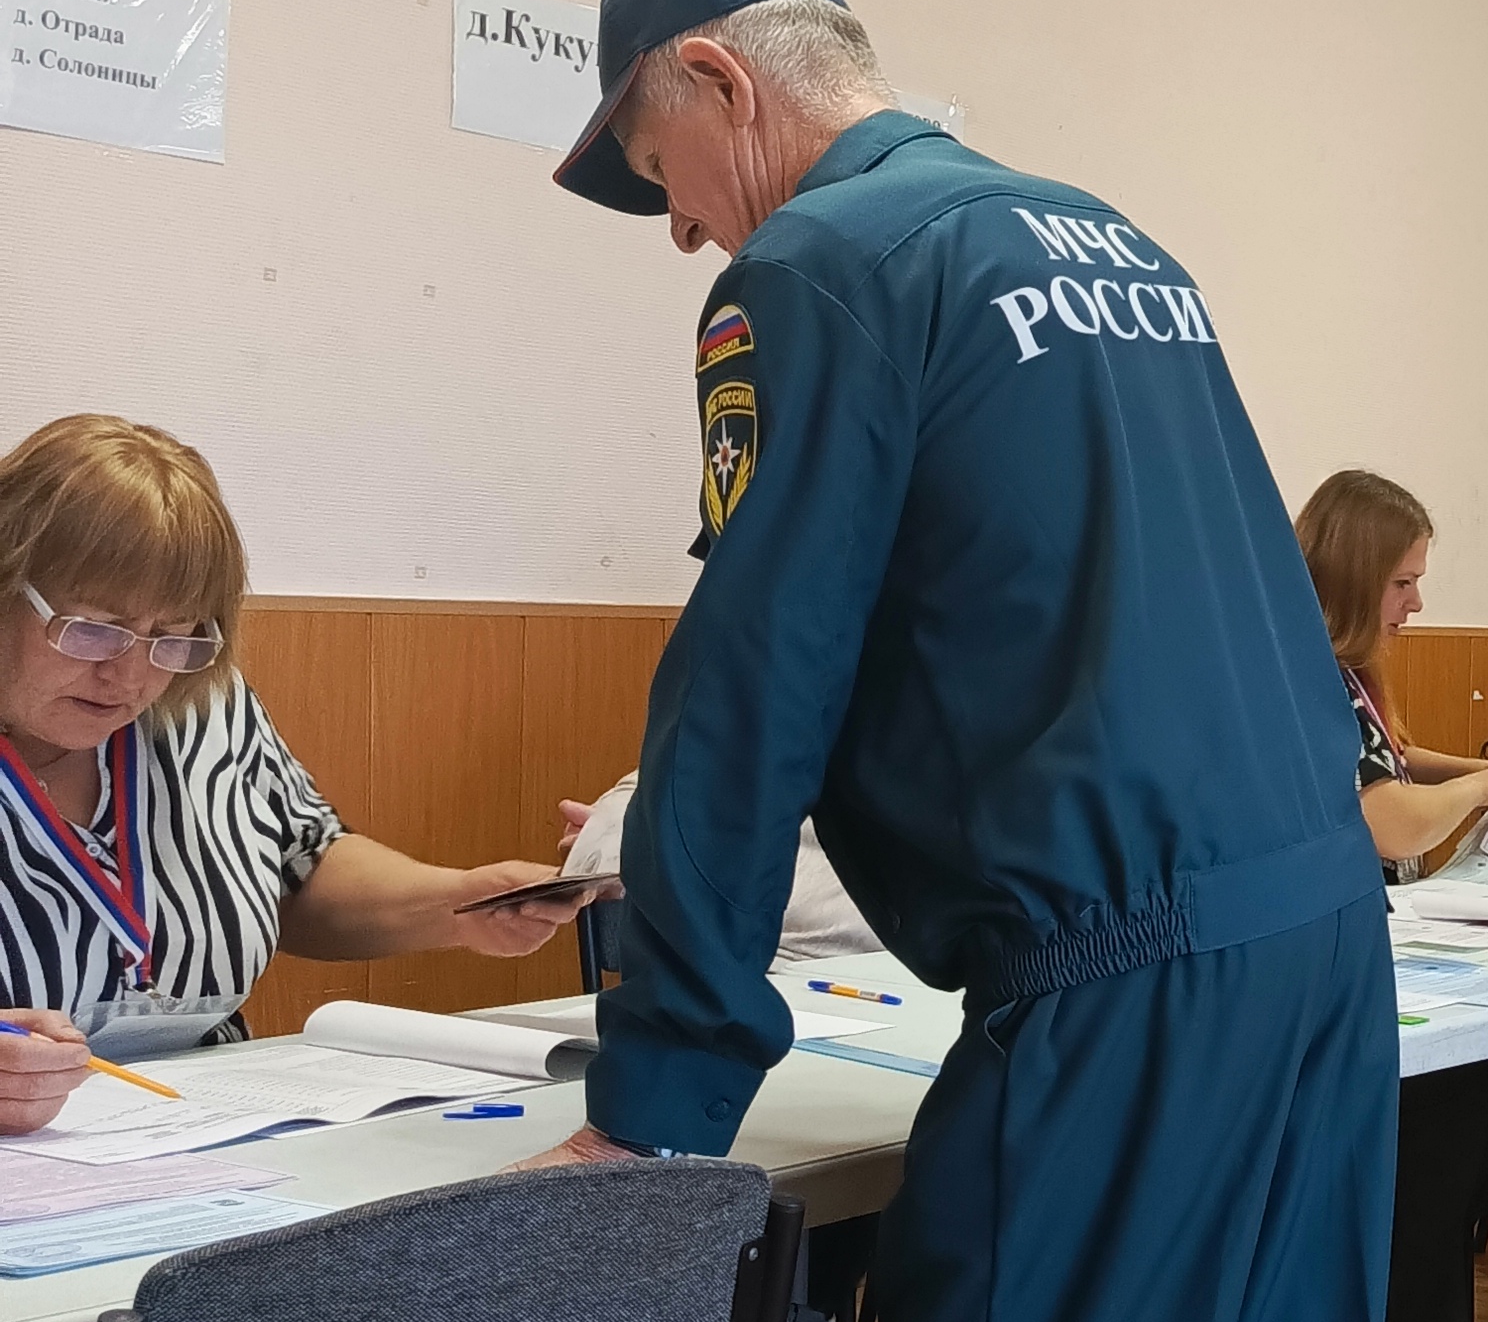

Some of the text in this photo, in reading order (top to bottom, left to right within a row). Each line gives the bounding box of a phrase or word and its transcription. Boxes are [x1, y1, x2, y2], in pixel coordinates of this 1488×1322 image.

[13, 8, 125, 46] д. Отрада
[465, 7, 600, 74] д.Куку
[11, 47, 159, 91] д. Солоницы
[1011, 207, 1160, 271] МЧС
[989, 275, 1218, 364] РОССИ
[706, 337, 740, 363] РОССИЯ
[718, 389, 754, 410] РОССИИ
